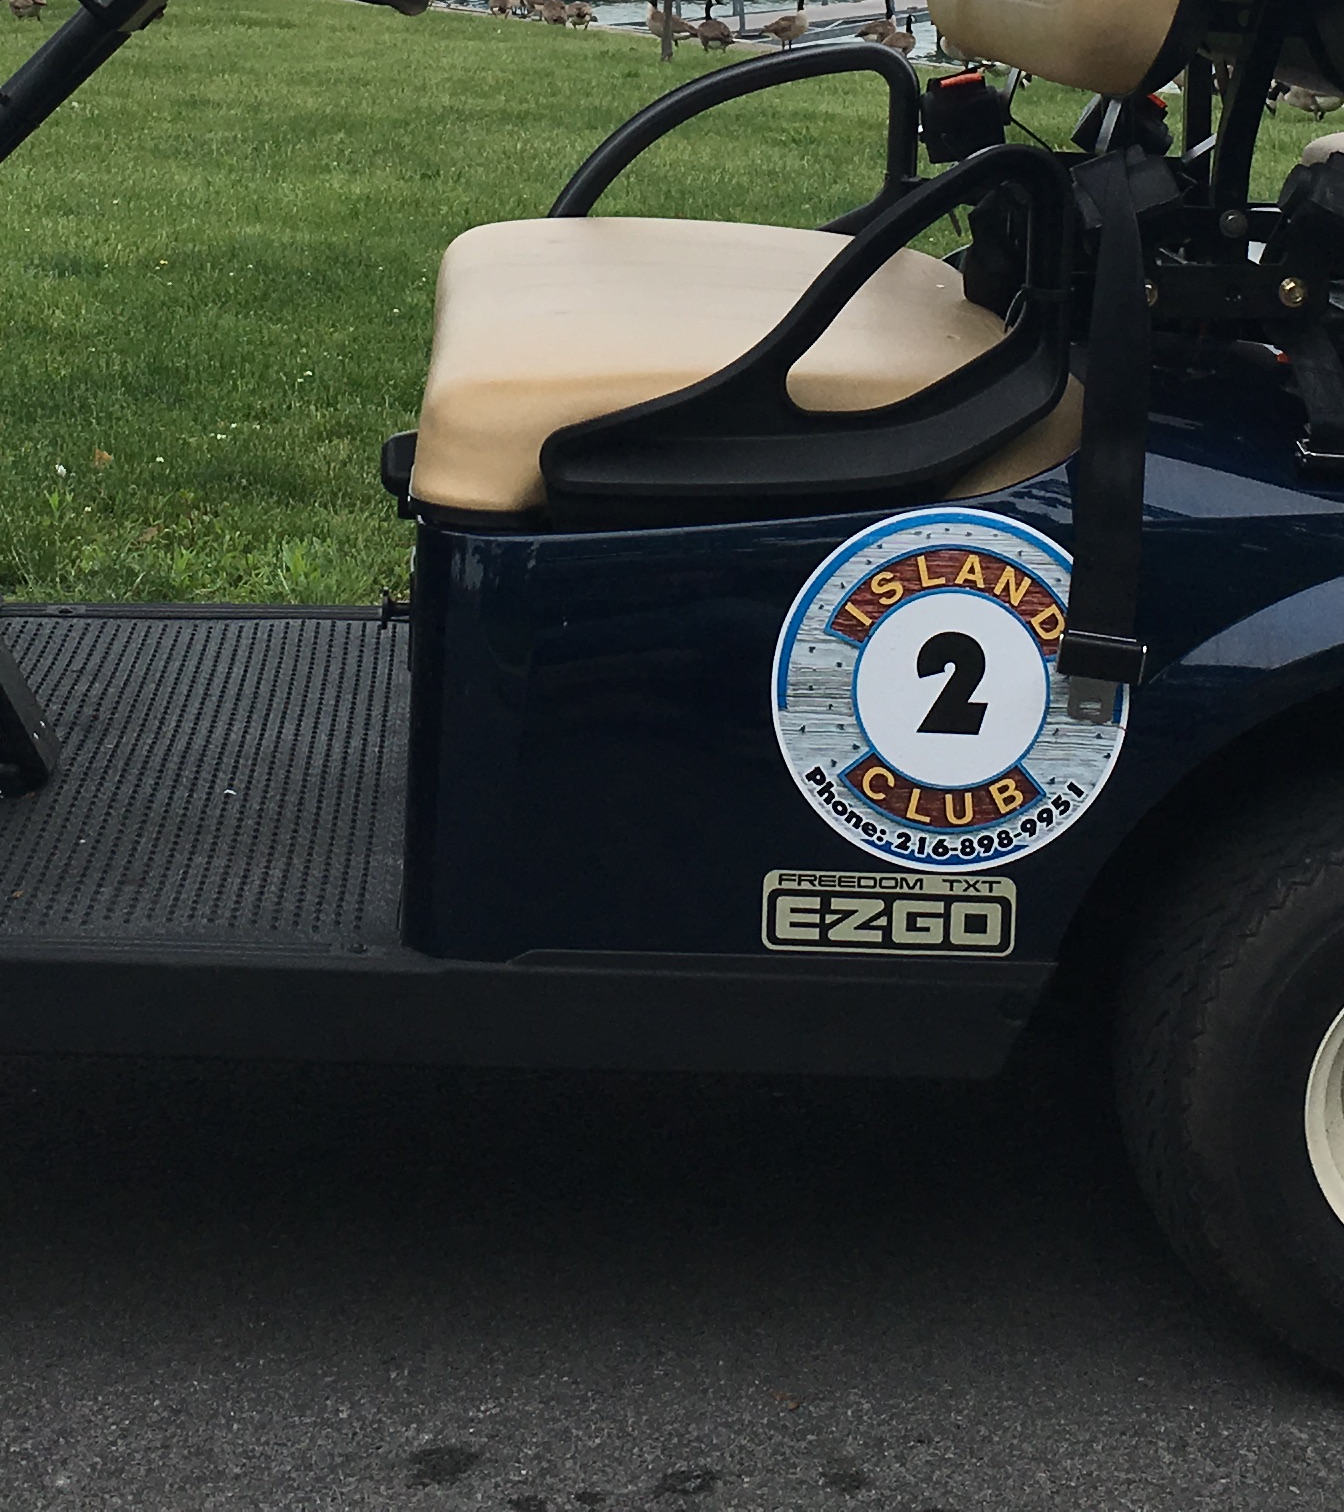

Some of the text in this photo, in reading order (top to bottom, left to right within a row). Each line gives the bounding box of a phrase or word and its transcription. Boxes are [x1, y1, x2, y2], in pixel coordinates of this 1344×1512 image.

[844, 553, 1067, 640] ISLAND
[916, 631, 989, 736] 2
[805, 765, 1086, 858] Phone: 216-898-9951
[862, 766, 1024, 825] CLUB
[777, 873, 1002, 893] FREEDOM TXT
